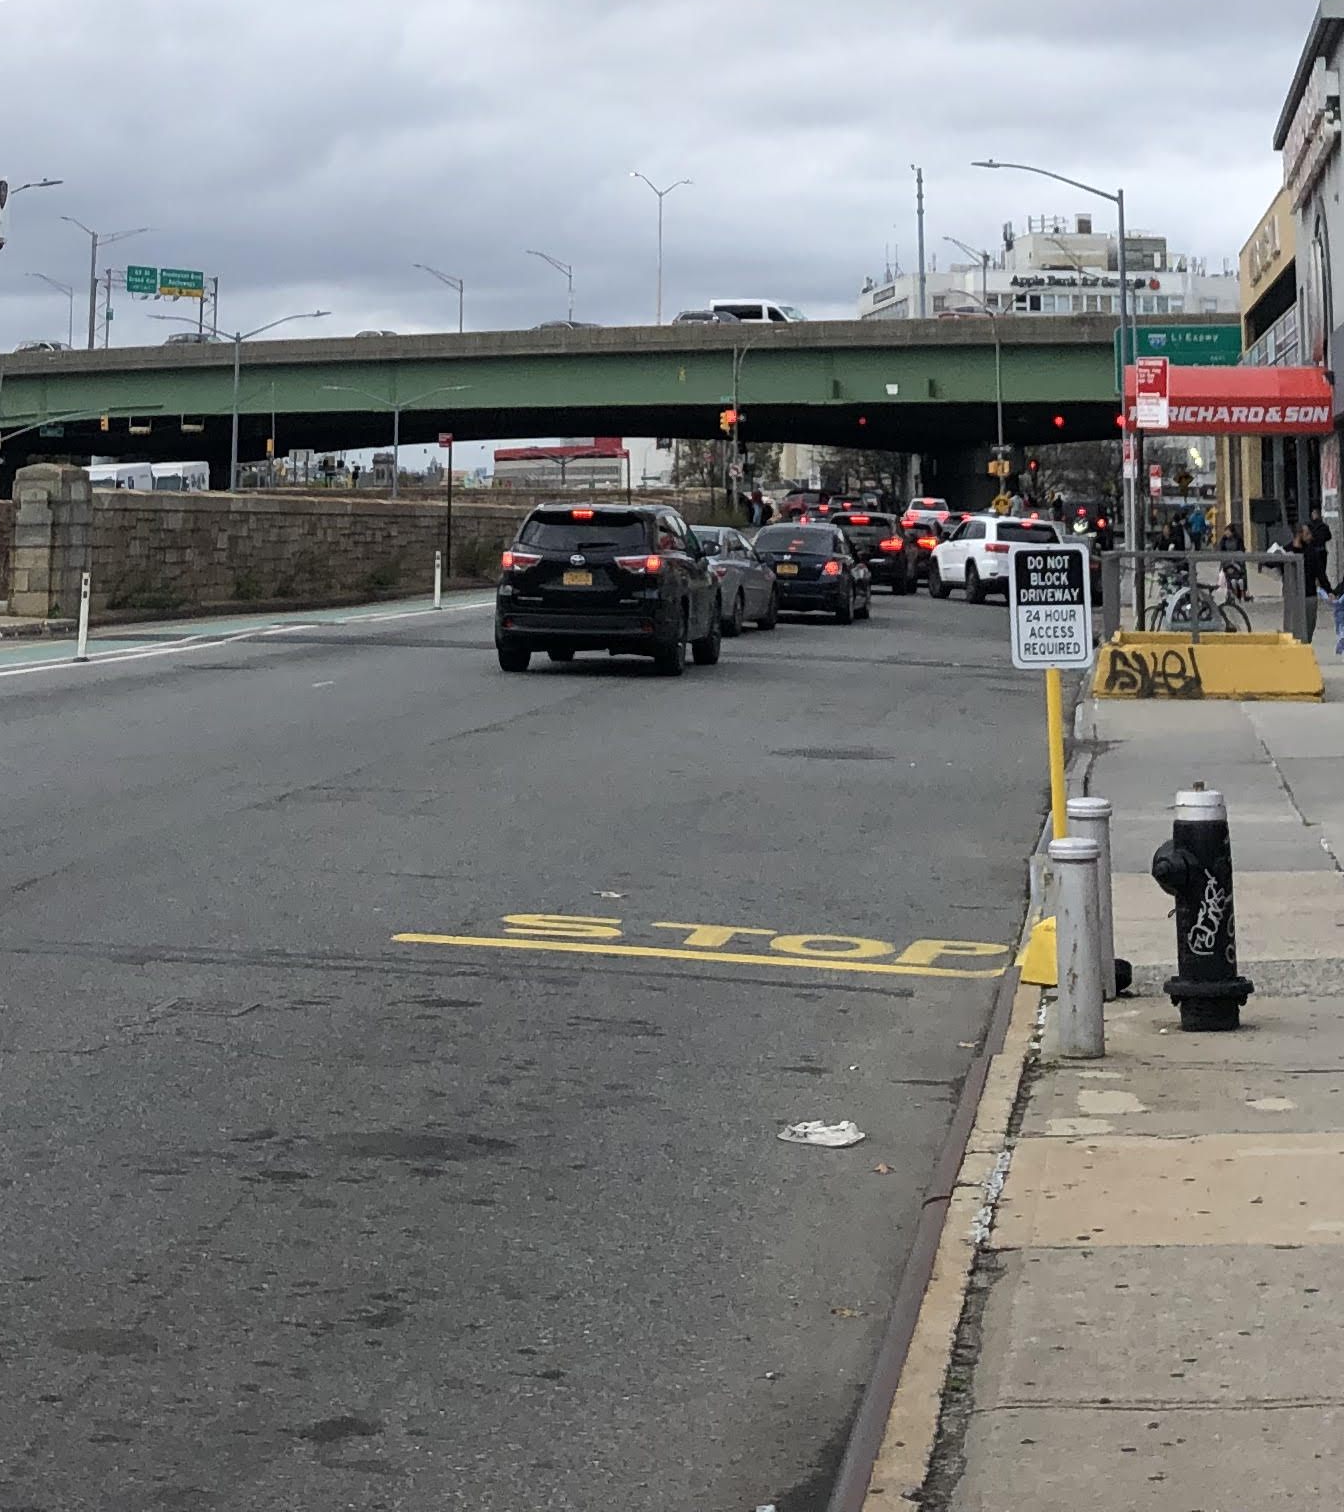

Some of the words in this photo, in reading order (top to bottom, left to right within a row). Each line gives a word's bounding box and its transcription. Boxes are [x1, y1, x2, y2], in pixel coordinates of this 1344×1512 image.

[1168, 406, 1263, 423] RICHARD
[1265, 406, 1282, 422] &
[1284, 406, 1329, 422] SON
[1027, 556, 1043, 569] DO
[1047, 555, 1070, 569] NOT
[1030, 572, 1069, 586] BLOCK
[1020, 588, 1079, 602] DRIVEWAY
[1026, 610, 1040, 623] 24
[1044, 609, 1076, 622] HOUR
[1029, 626, 1074, 638] ACCESS
[1023, 642, 1081, 655] REQUIRED
[501, 913, 1012, 969] STOP
